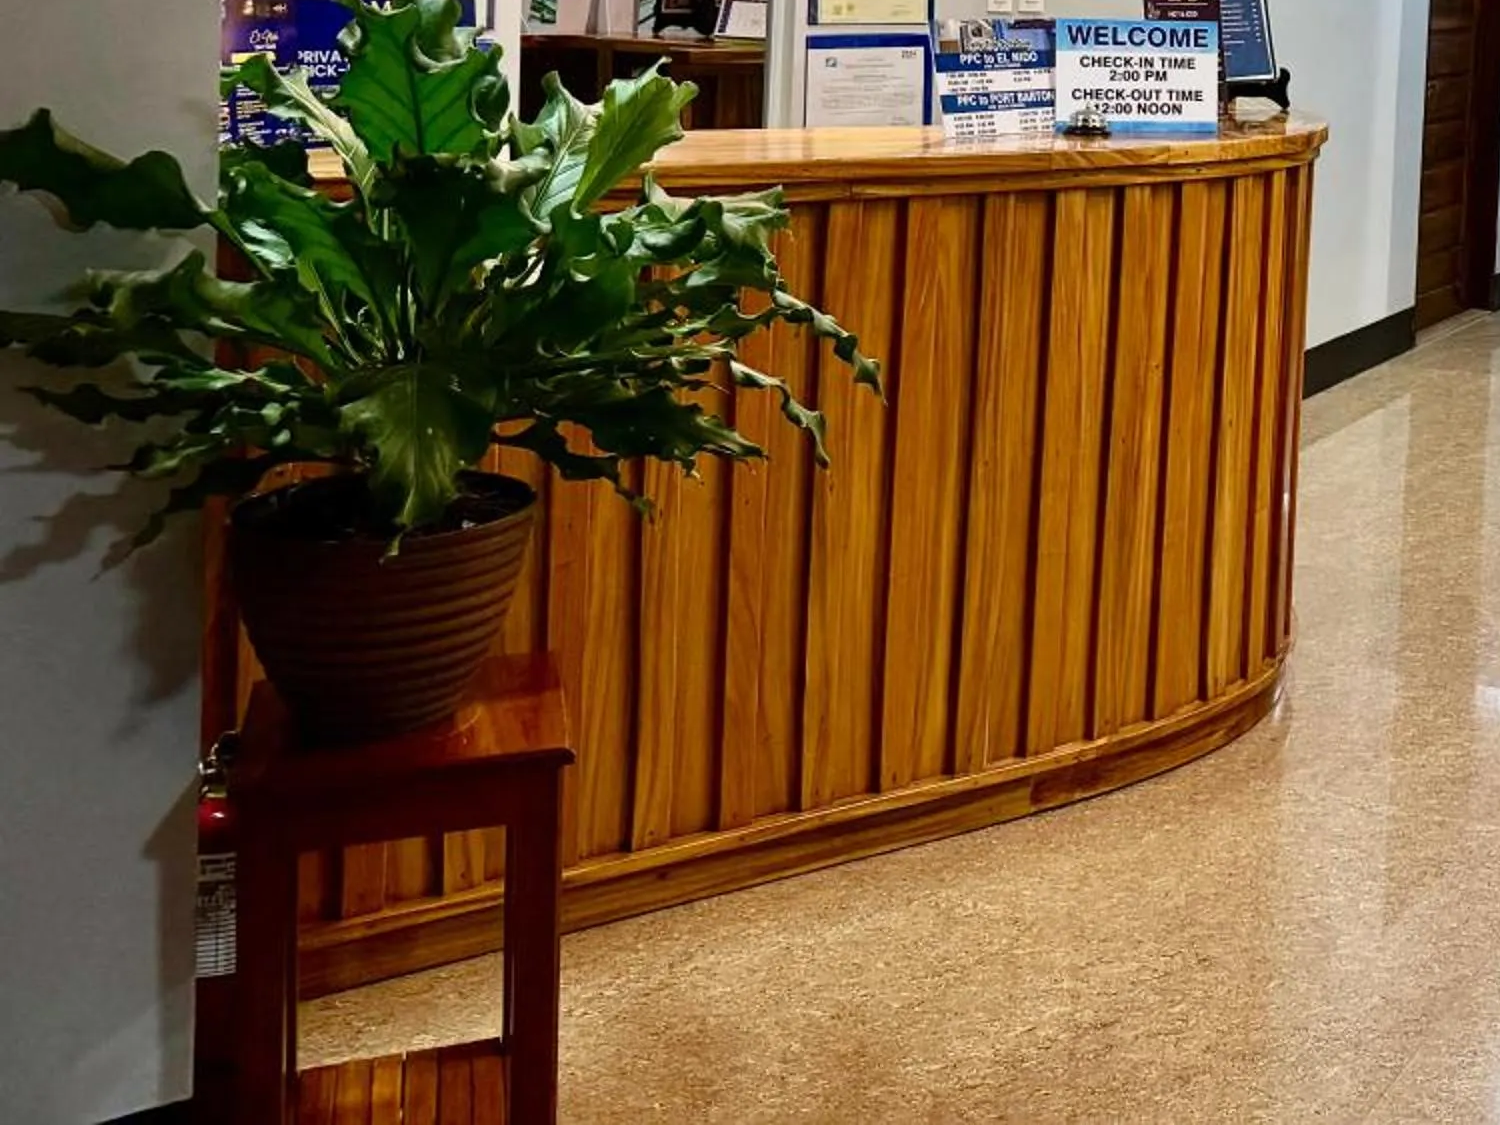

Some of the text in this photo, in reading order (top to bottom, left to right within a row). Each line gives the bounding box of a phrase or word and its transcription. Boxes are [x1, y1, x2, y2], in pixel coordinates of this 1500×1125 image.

[1067, 24, 1209, 48] WELCOME
[1079, 55, 1197, 70] CHECK-IN TIME
[1109, 70, 1168, 82] 2:00 PM
[1071, 88, 1204, 102] CHECK-OUT TIME
[1137, 103, 1183, 116] NOON
